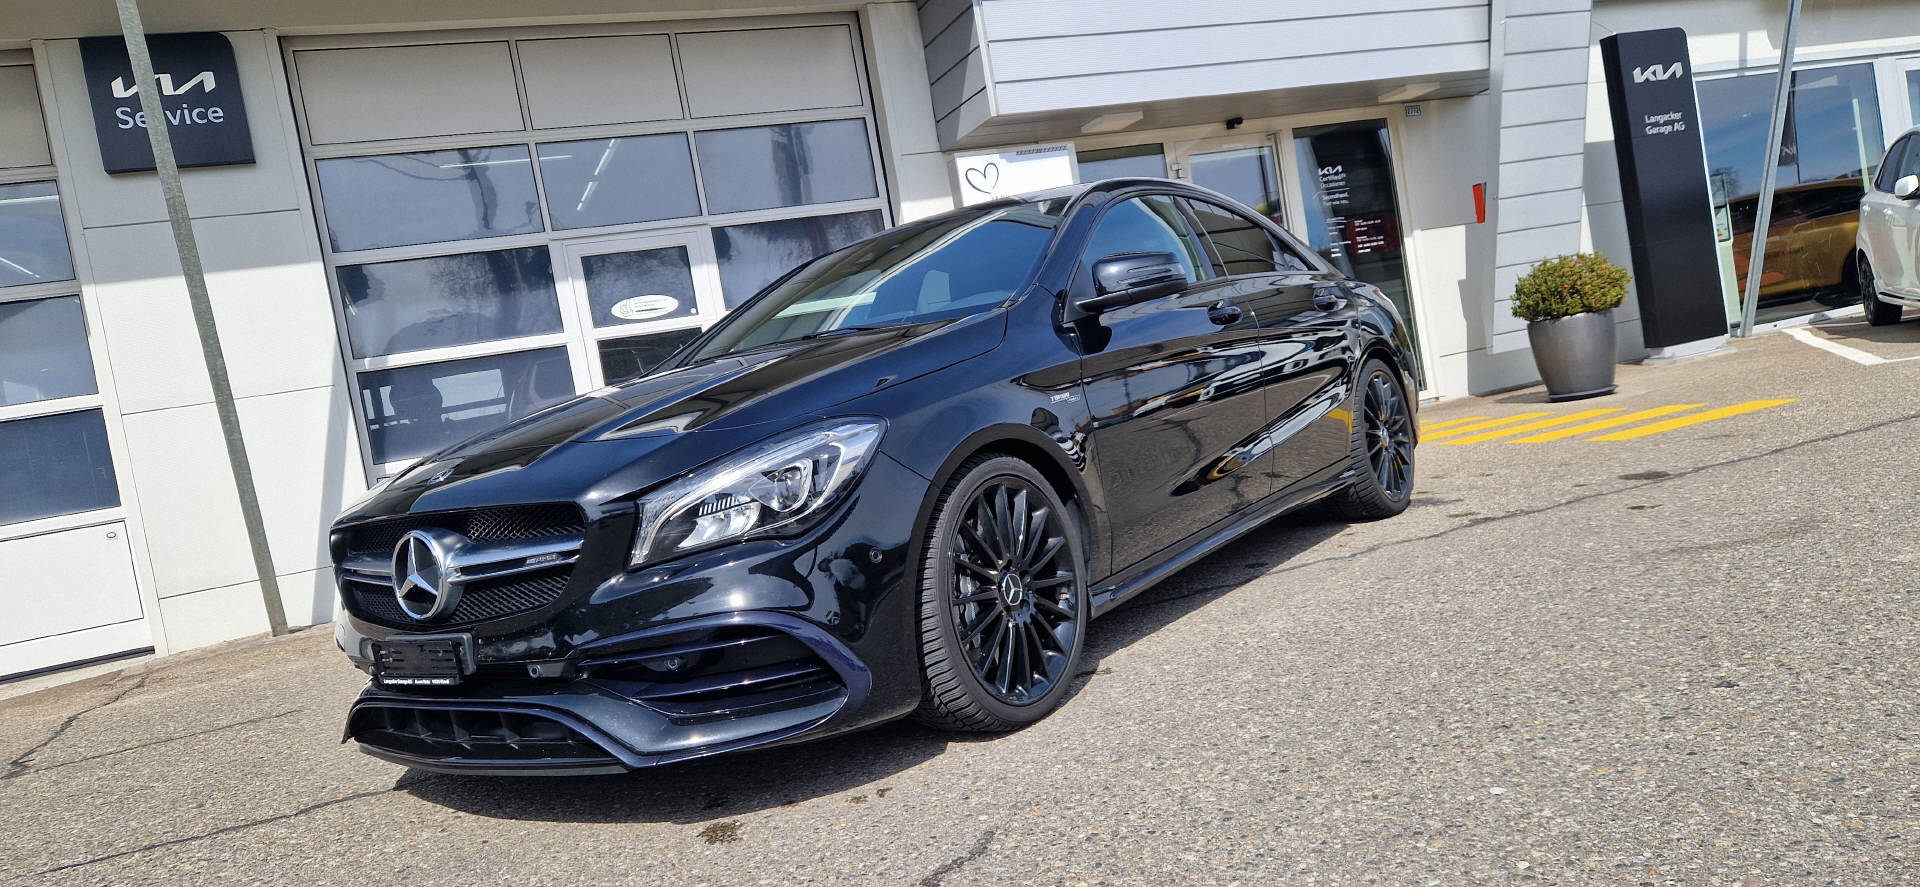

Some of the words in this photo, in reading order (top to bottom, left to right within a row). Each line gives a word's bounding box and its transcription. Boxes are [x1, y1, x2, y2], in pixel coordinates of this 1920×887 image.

[1633, 61, 1683, 83] KIA
[115, 103, 224, 129] Sevice
[1645, 111, 1683, 124] Langacker
[1645, 124, 1673, 135] Garage
[1674, 121, 1686, 132] AG
[1318, 165, 1342, 175] KIA
